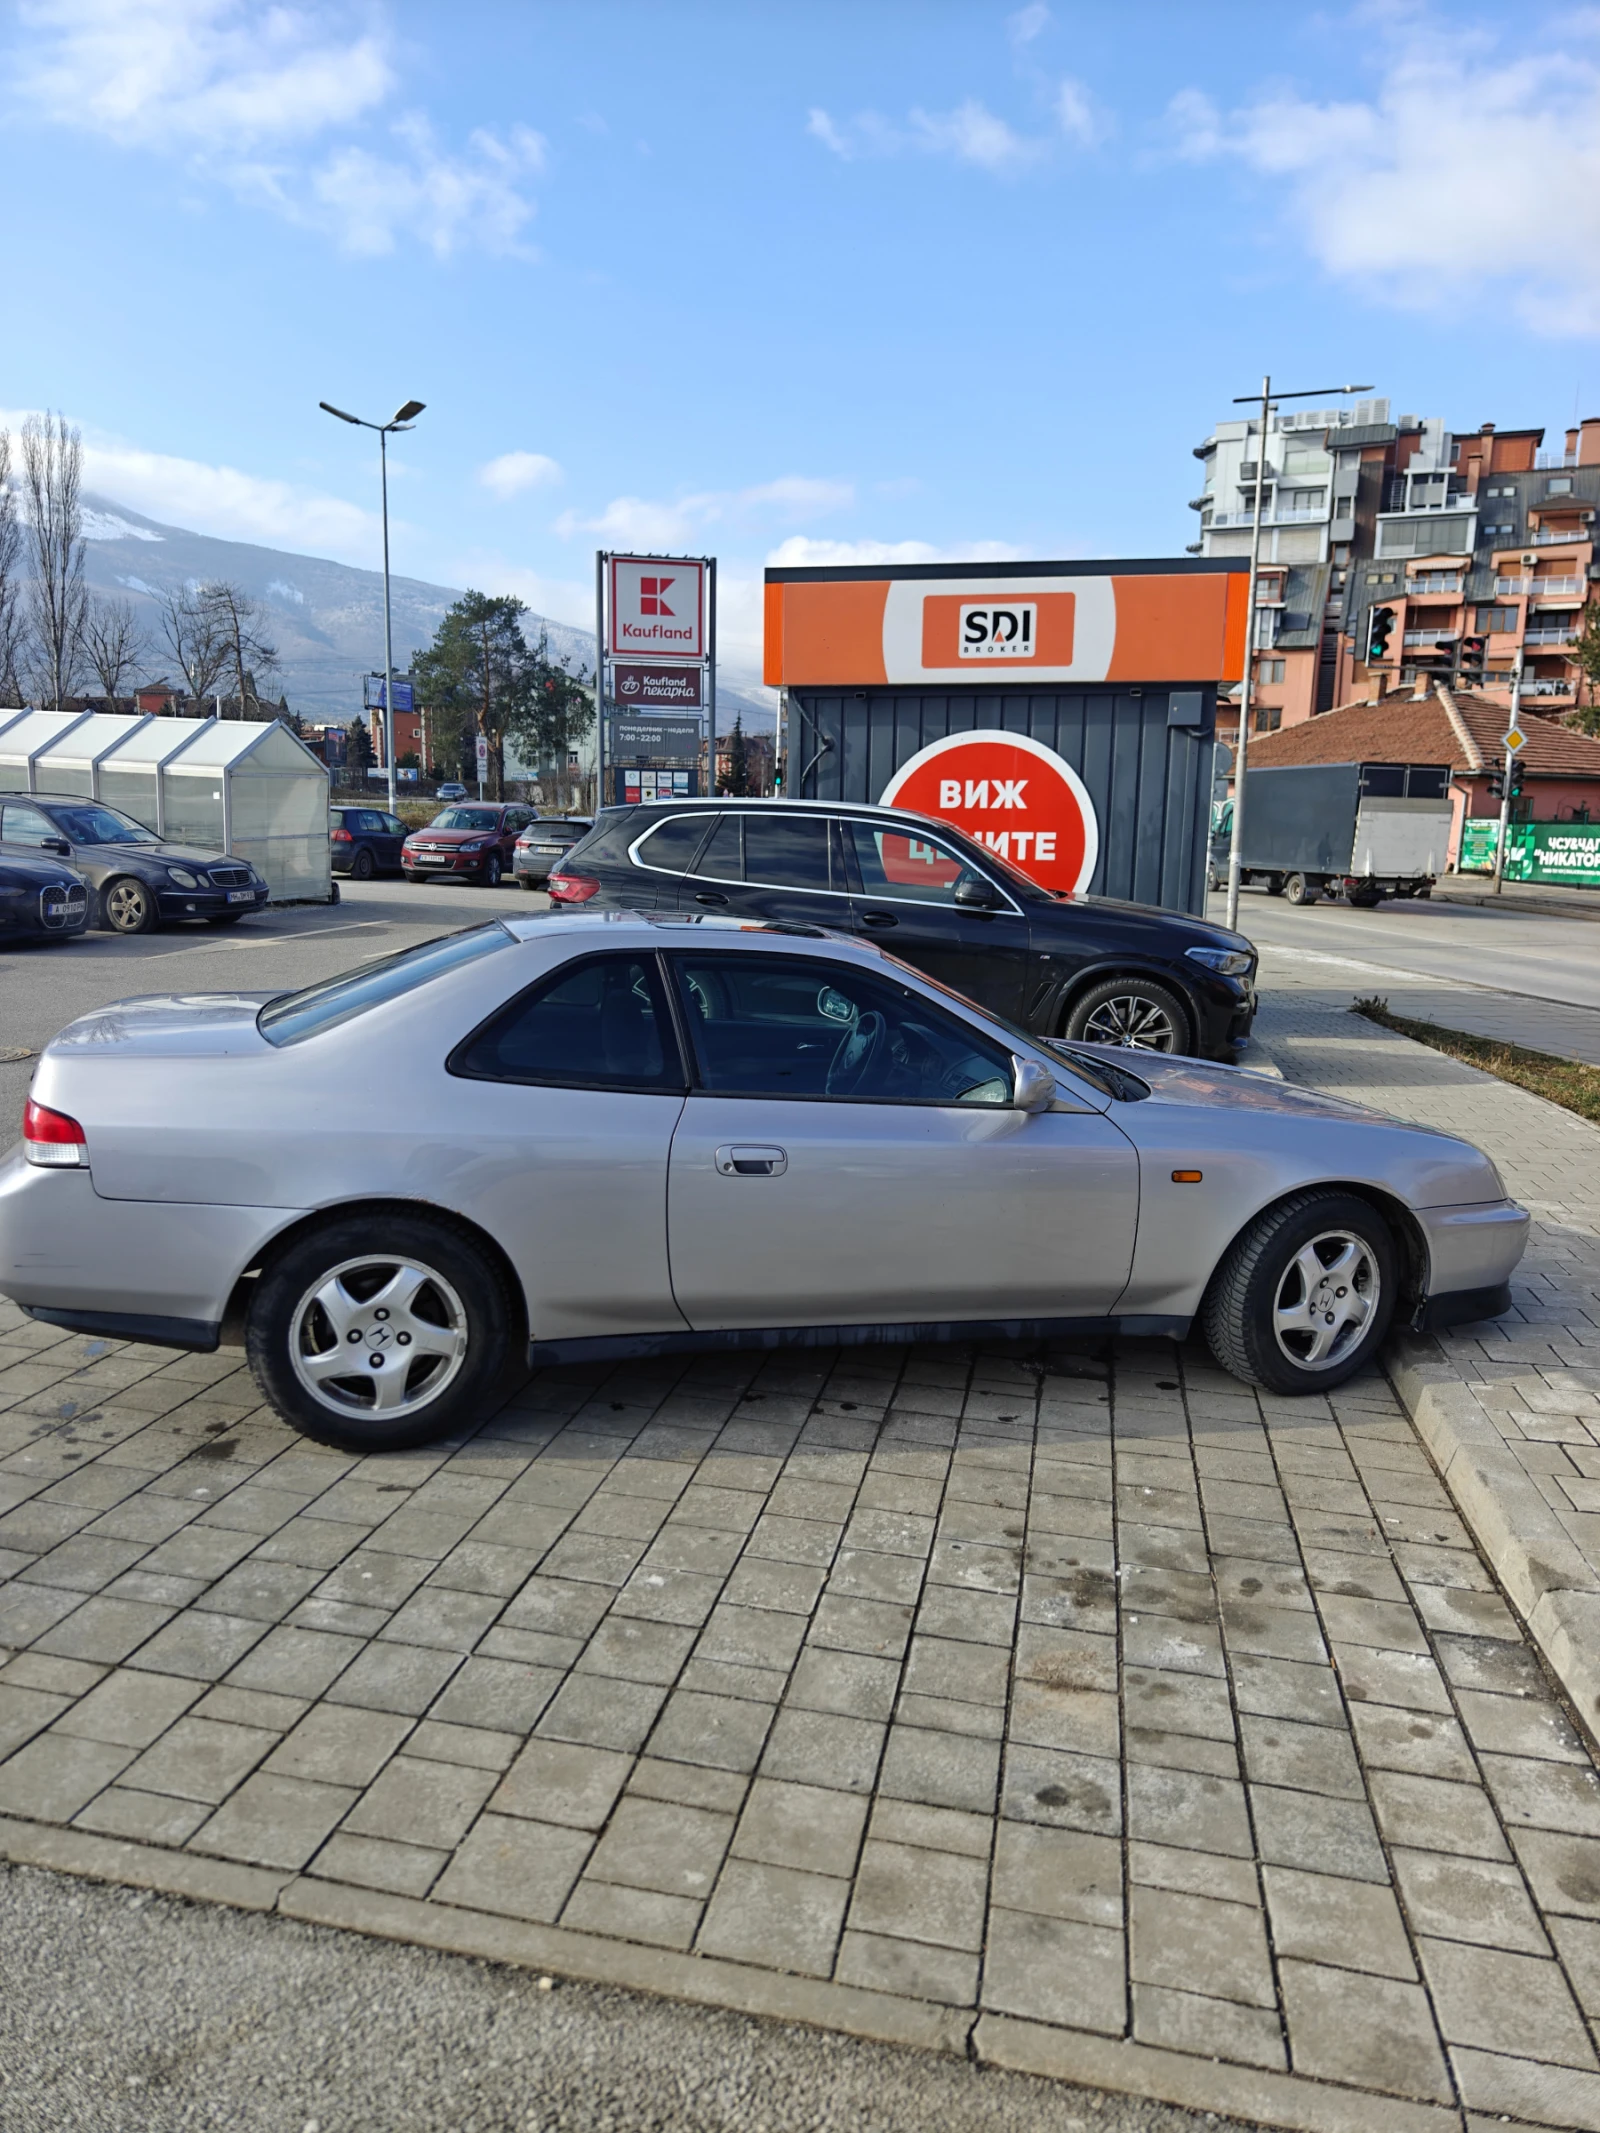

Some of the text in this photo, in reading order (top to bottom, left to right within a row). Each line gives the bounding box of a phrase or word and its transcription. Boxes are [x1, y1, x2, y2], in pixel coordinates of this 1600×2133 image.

[622, 623, 693, 640] Kaufland
[964, 609, 1031, 644] SDI
[963, 645, 1030, 653] BROKER
[642, 675, 687, 687] Kaufland
[642, 685, 696, 699] пекарна
[619, 734, 636, 742] 7:00
[640, 734, 662, 742] 22:00
[939, 779, 1029, 810] ВИЖ
[908, 831, 1057, 865] ЦИТЕ
